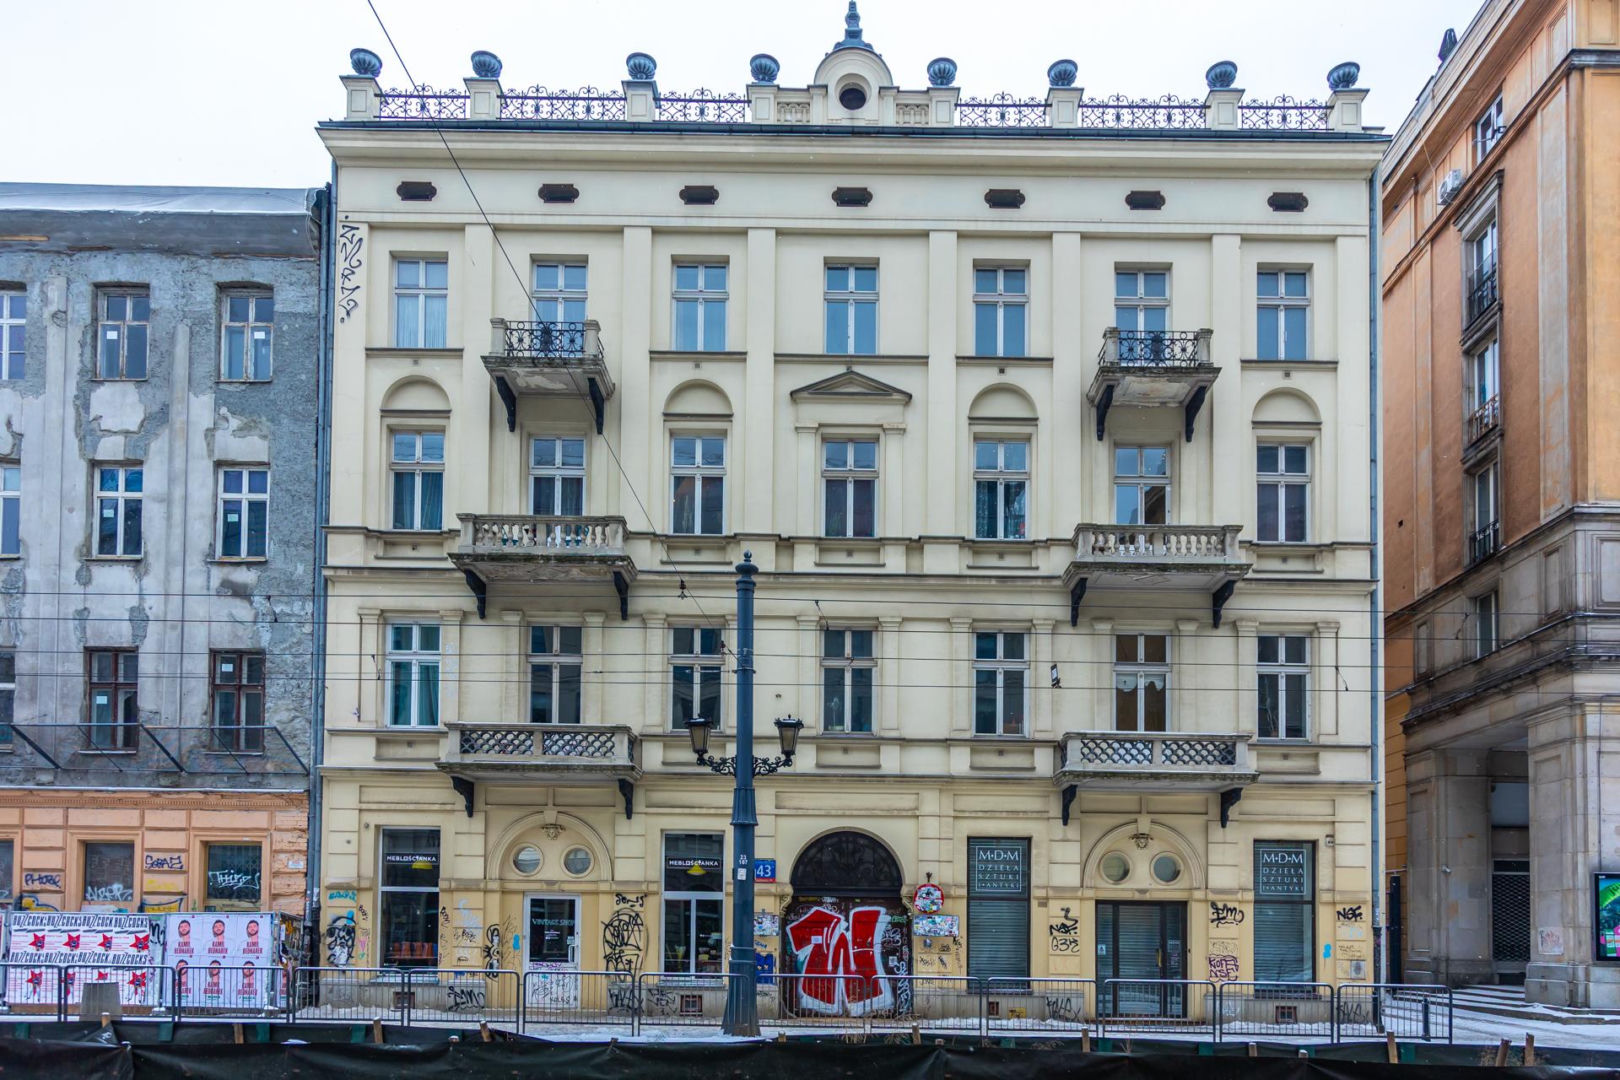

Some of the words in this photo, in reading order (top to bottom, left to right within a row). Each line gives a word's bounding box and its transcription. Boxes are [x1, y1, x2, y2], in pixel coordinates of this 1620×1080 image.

[757, 865, 771, 877] 43
[113, 915, 148, 929] BUZZCOCKS
[112, 952, 148, 965] BUZZCOCKS
